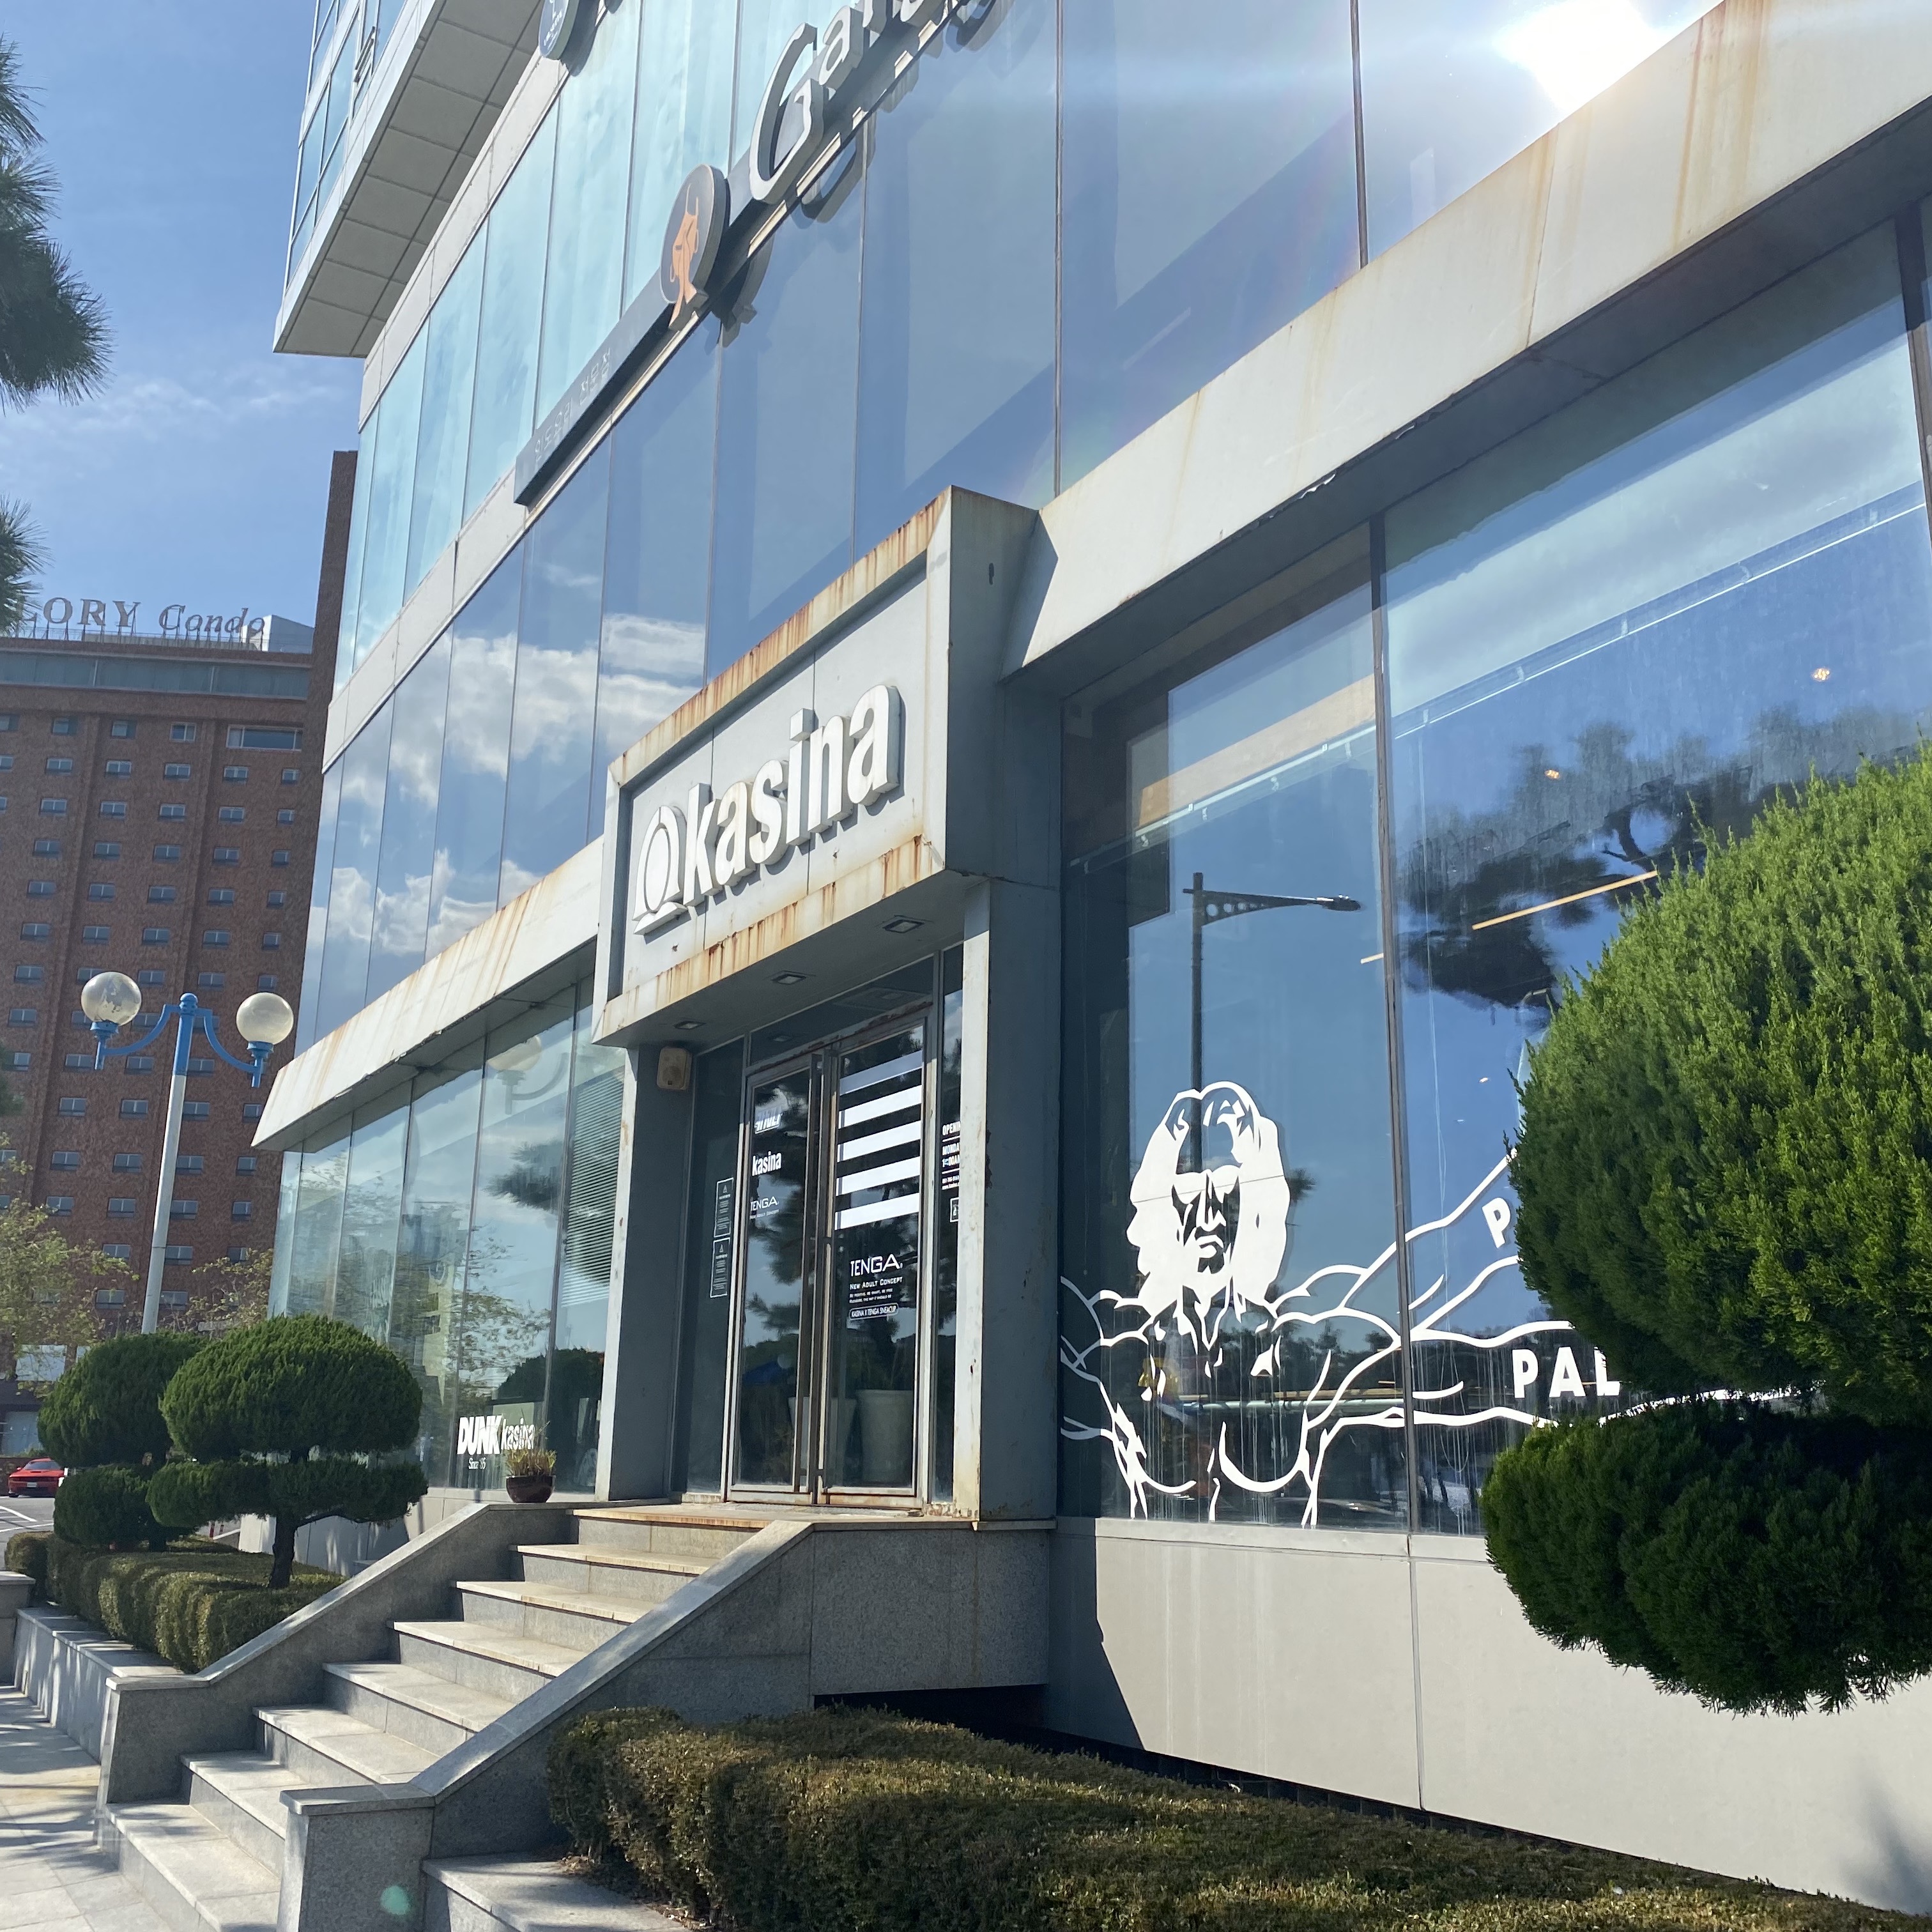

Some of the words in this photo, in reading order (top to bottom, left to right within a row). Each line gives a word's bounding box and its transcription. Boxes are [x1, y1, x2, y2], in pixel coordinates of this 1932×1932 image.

[159, 604, 264, 632] Condo
[683, 684, 900, 907] kasina
[942, 1142, 960, 1155] MONDA
[752, 1151, 782, 1176] kasina
[751, 1197, 778, 1211] TENGA
[1482, 1197, 1511, 1248] P
[850, 1254, 900, 1276] TENGA
[457, 1415, 503, 1455] DUNK
[501, 1418, 535, 1450] kasina
